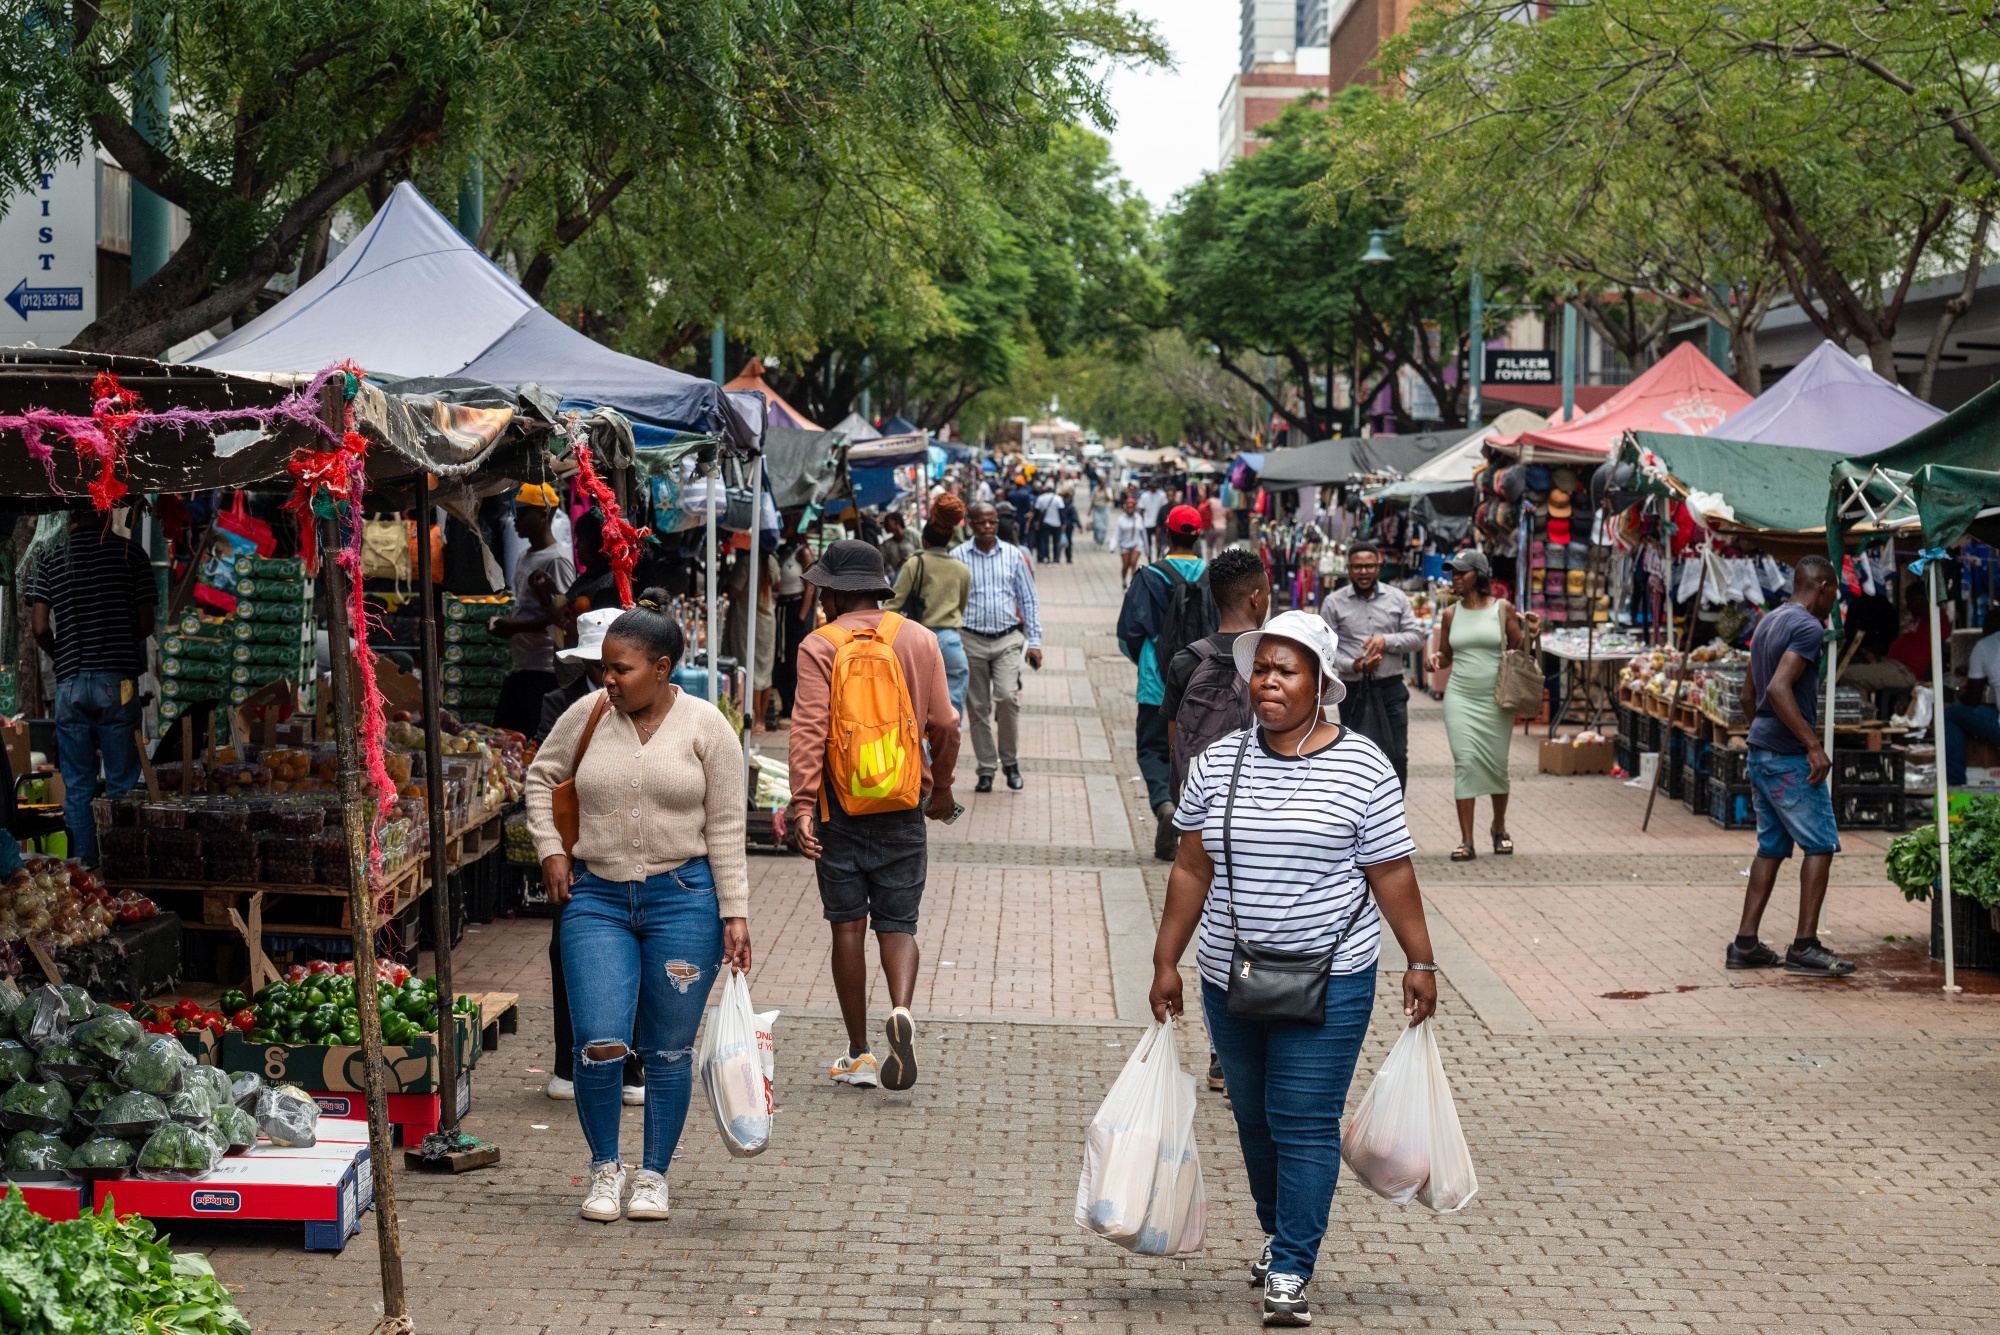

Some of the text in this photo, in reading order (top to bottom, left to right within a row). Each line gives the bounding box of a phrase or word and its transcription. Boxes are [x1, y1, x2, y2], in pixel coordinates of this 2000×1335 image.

[20, 294, 79, 309] (012) 326 7168
[1496, 357, 1549, 369] FILKEM
[1495, 369, 1552, 380] TOWERS
[859, 726, 899, 780] NIK
[196, 1197, 221, 1205] Rocha
